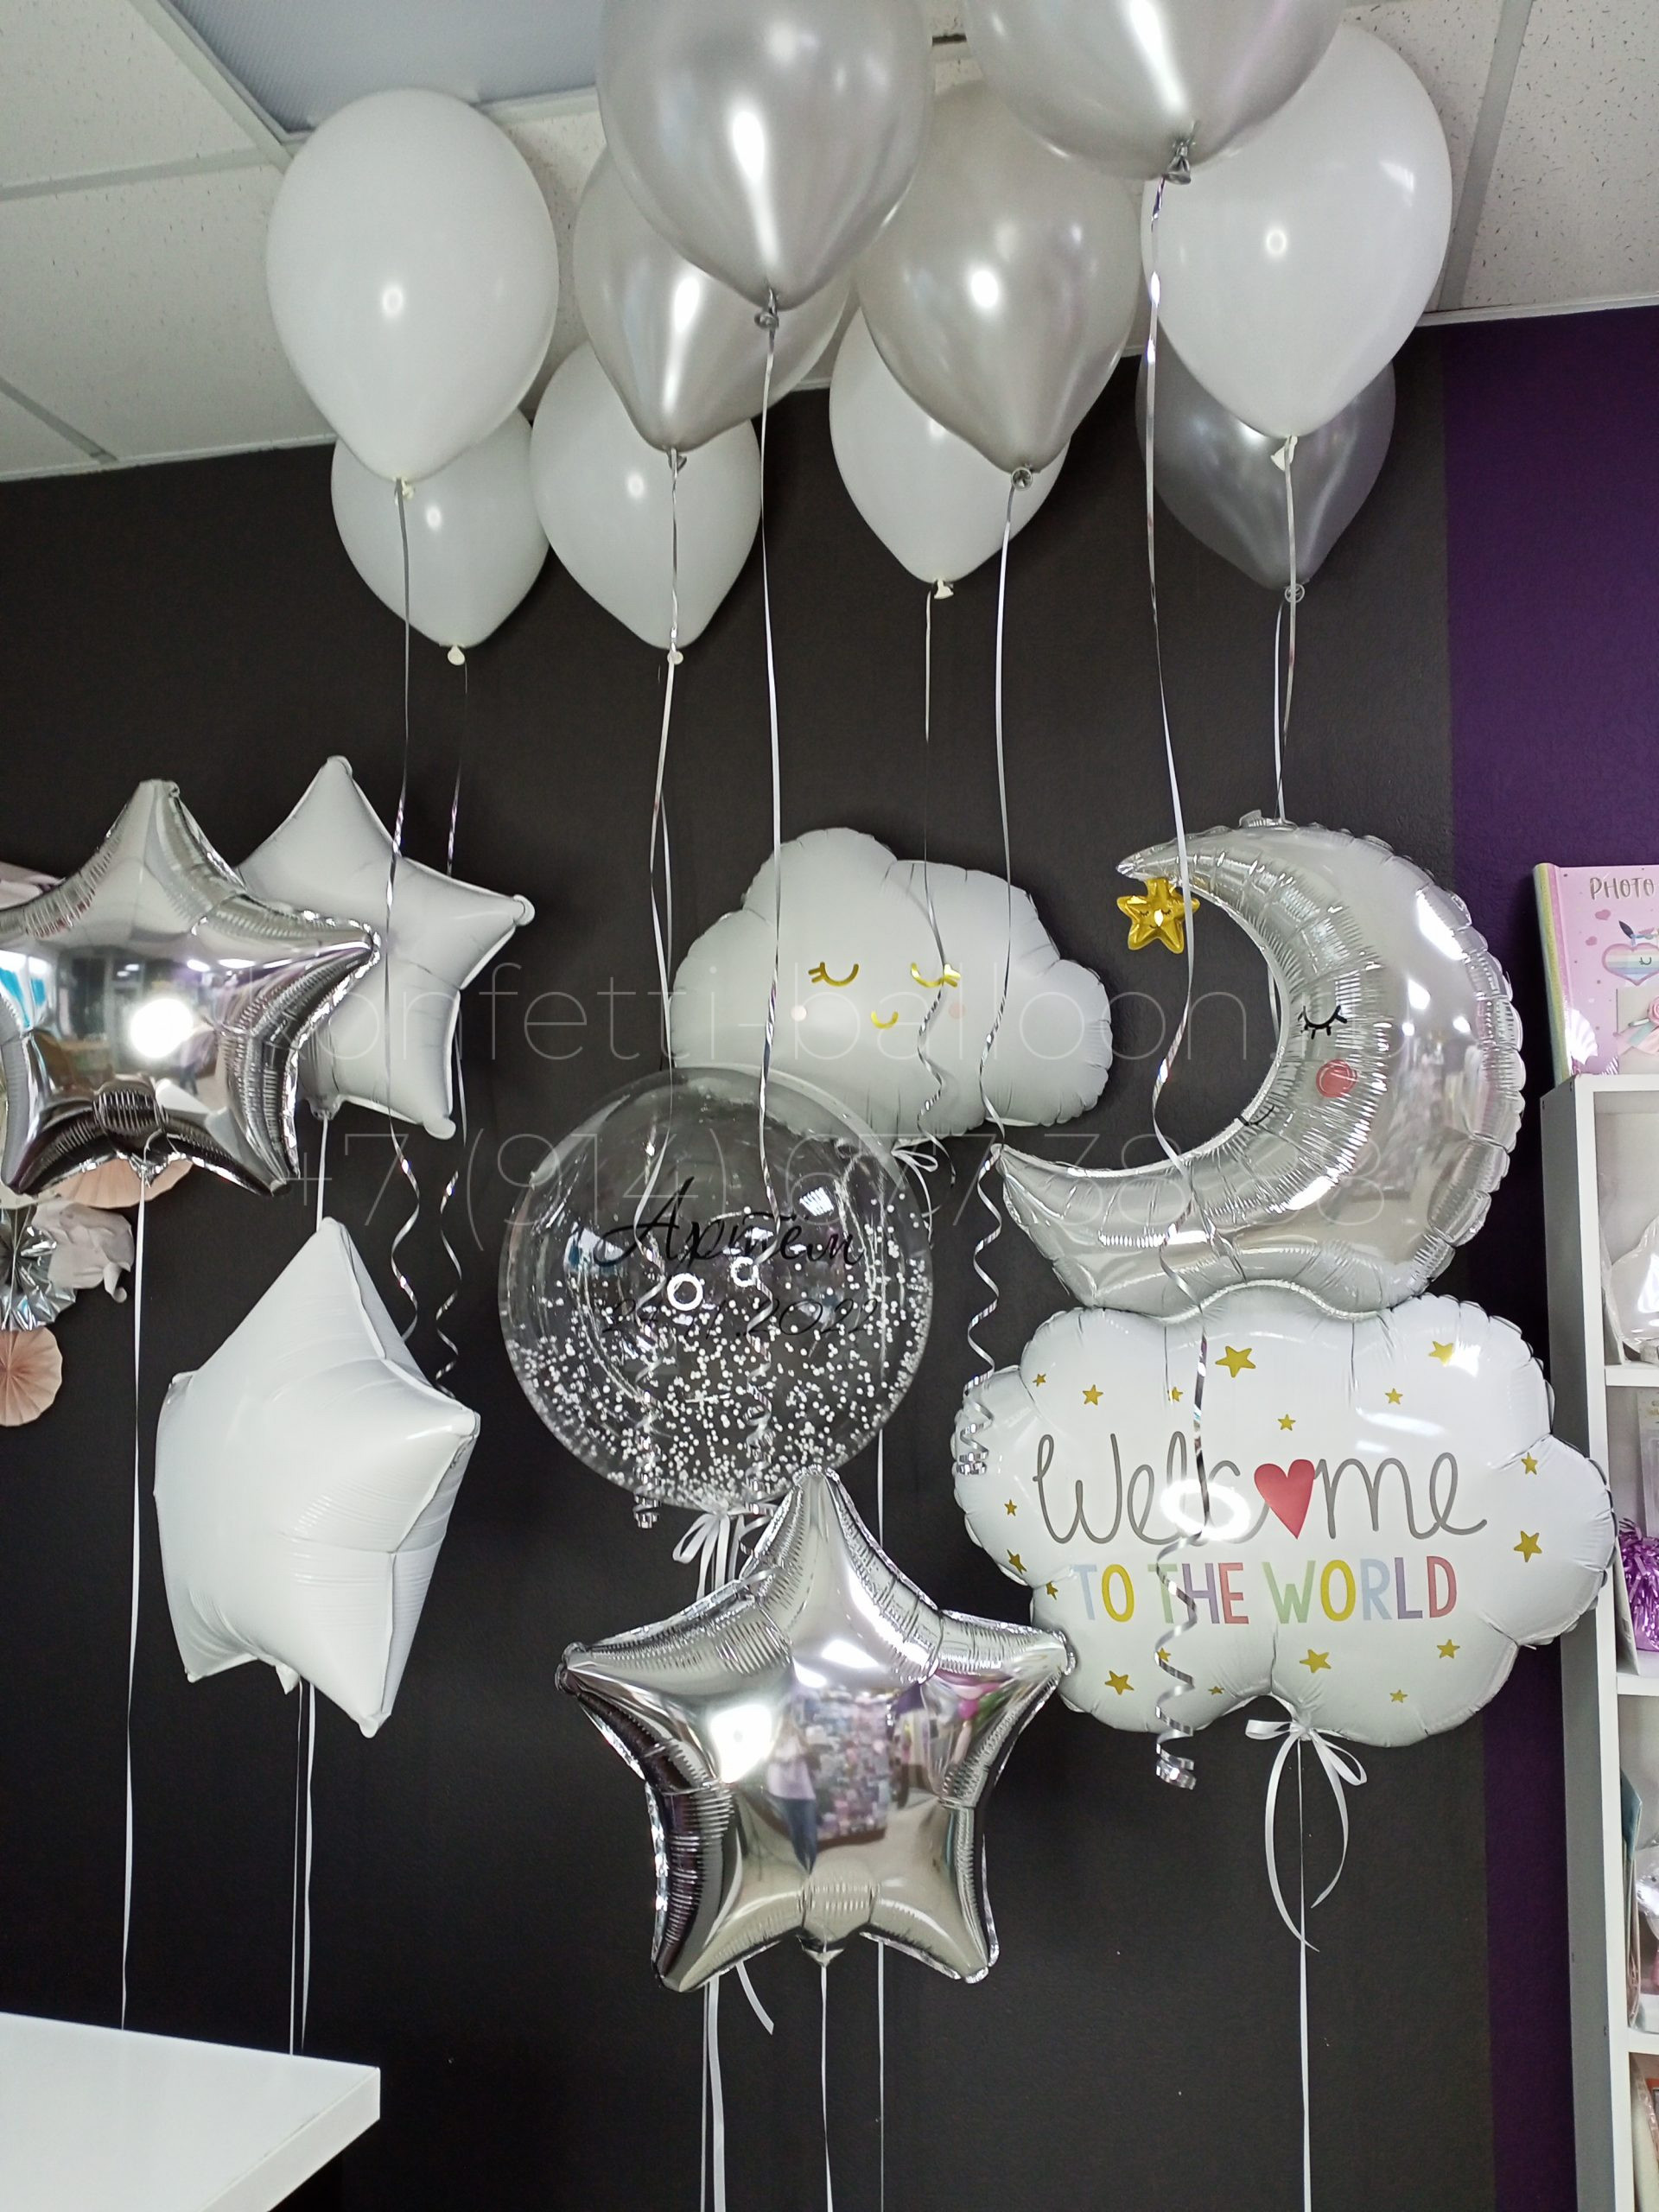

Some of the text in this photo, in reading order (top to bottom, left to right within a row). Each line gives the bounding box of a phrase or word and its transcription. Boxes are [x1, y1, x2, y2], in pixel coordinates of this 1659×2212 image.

[1590, 877, 1655, 899] PHOTO
[1073, 1556, 1457, 1624] TO THE WORLD
